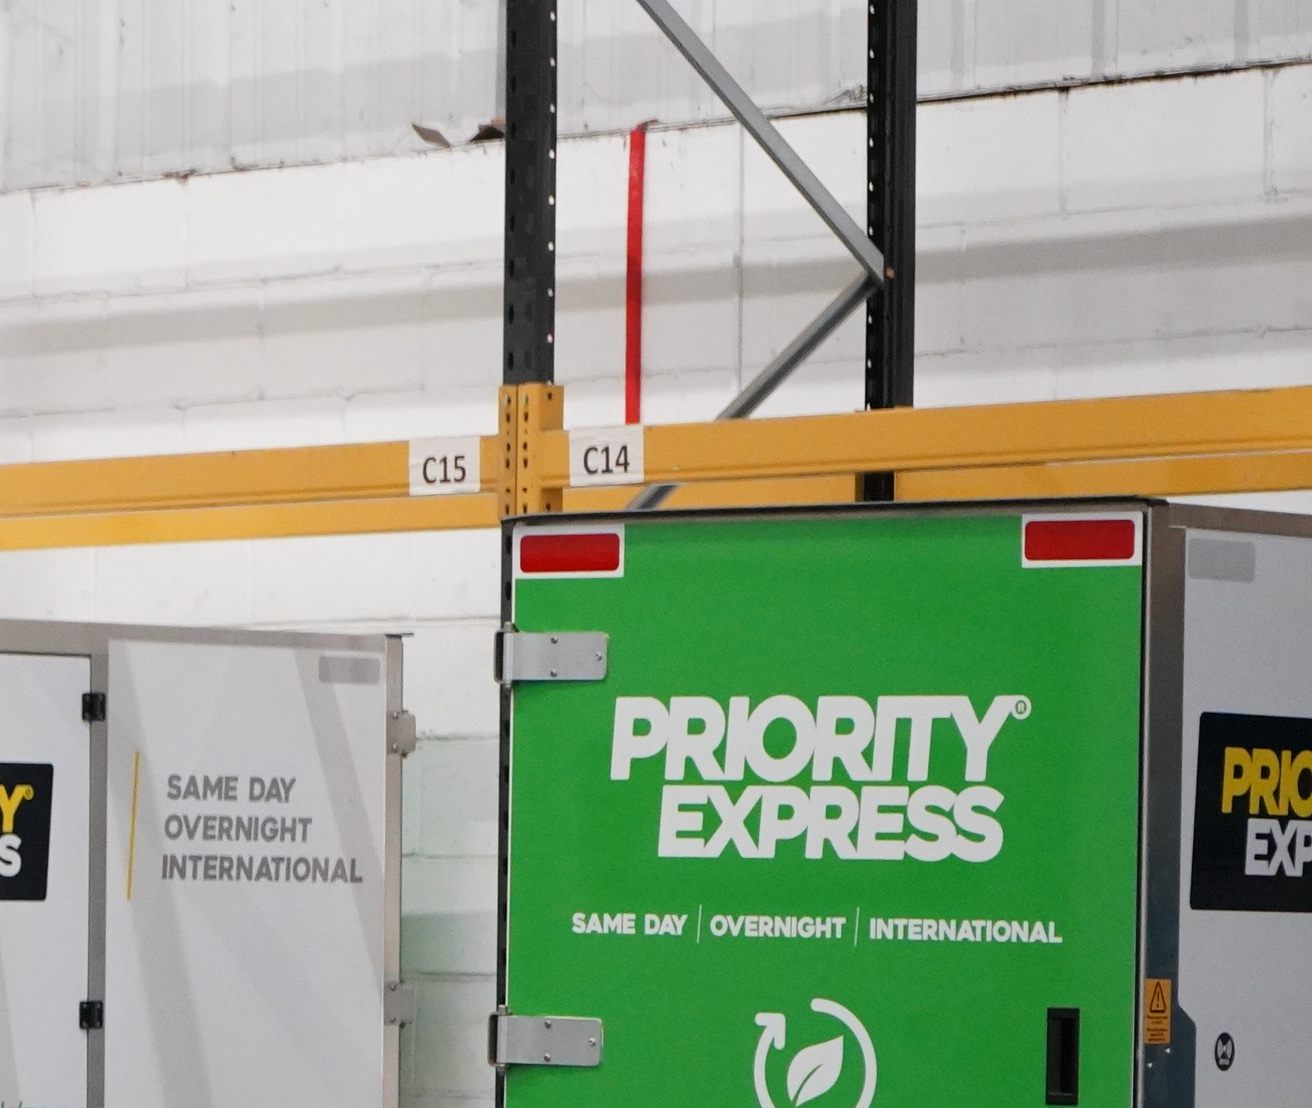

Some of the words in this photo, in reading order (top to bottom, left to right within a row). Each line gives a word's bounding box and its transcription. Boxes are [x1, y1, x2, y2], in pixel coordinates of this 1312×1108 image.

[422, 455, 466, 483] C15
[583, 445, 630, 474] C14
[167, 775, 239, 803] SAME
[248, 777, 297, 805] DAY
[164, 815, 313, 845] OVERNIGHT
[657, 785, 1005, 863] EXPRESS
[161, 855, 364, 885] INTERNATIONAL
[571, 912, 636, 936] SAME
[643, 913, 688, 937] DAY
[709, 914, 846, 939] OVERNIGHT
[869, 918, 1063, 944] INTERNATIONAL
